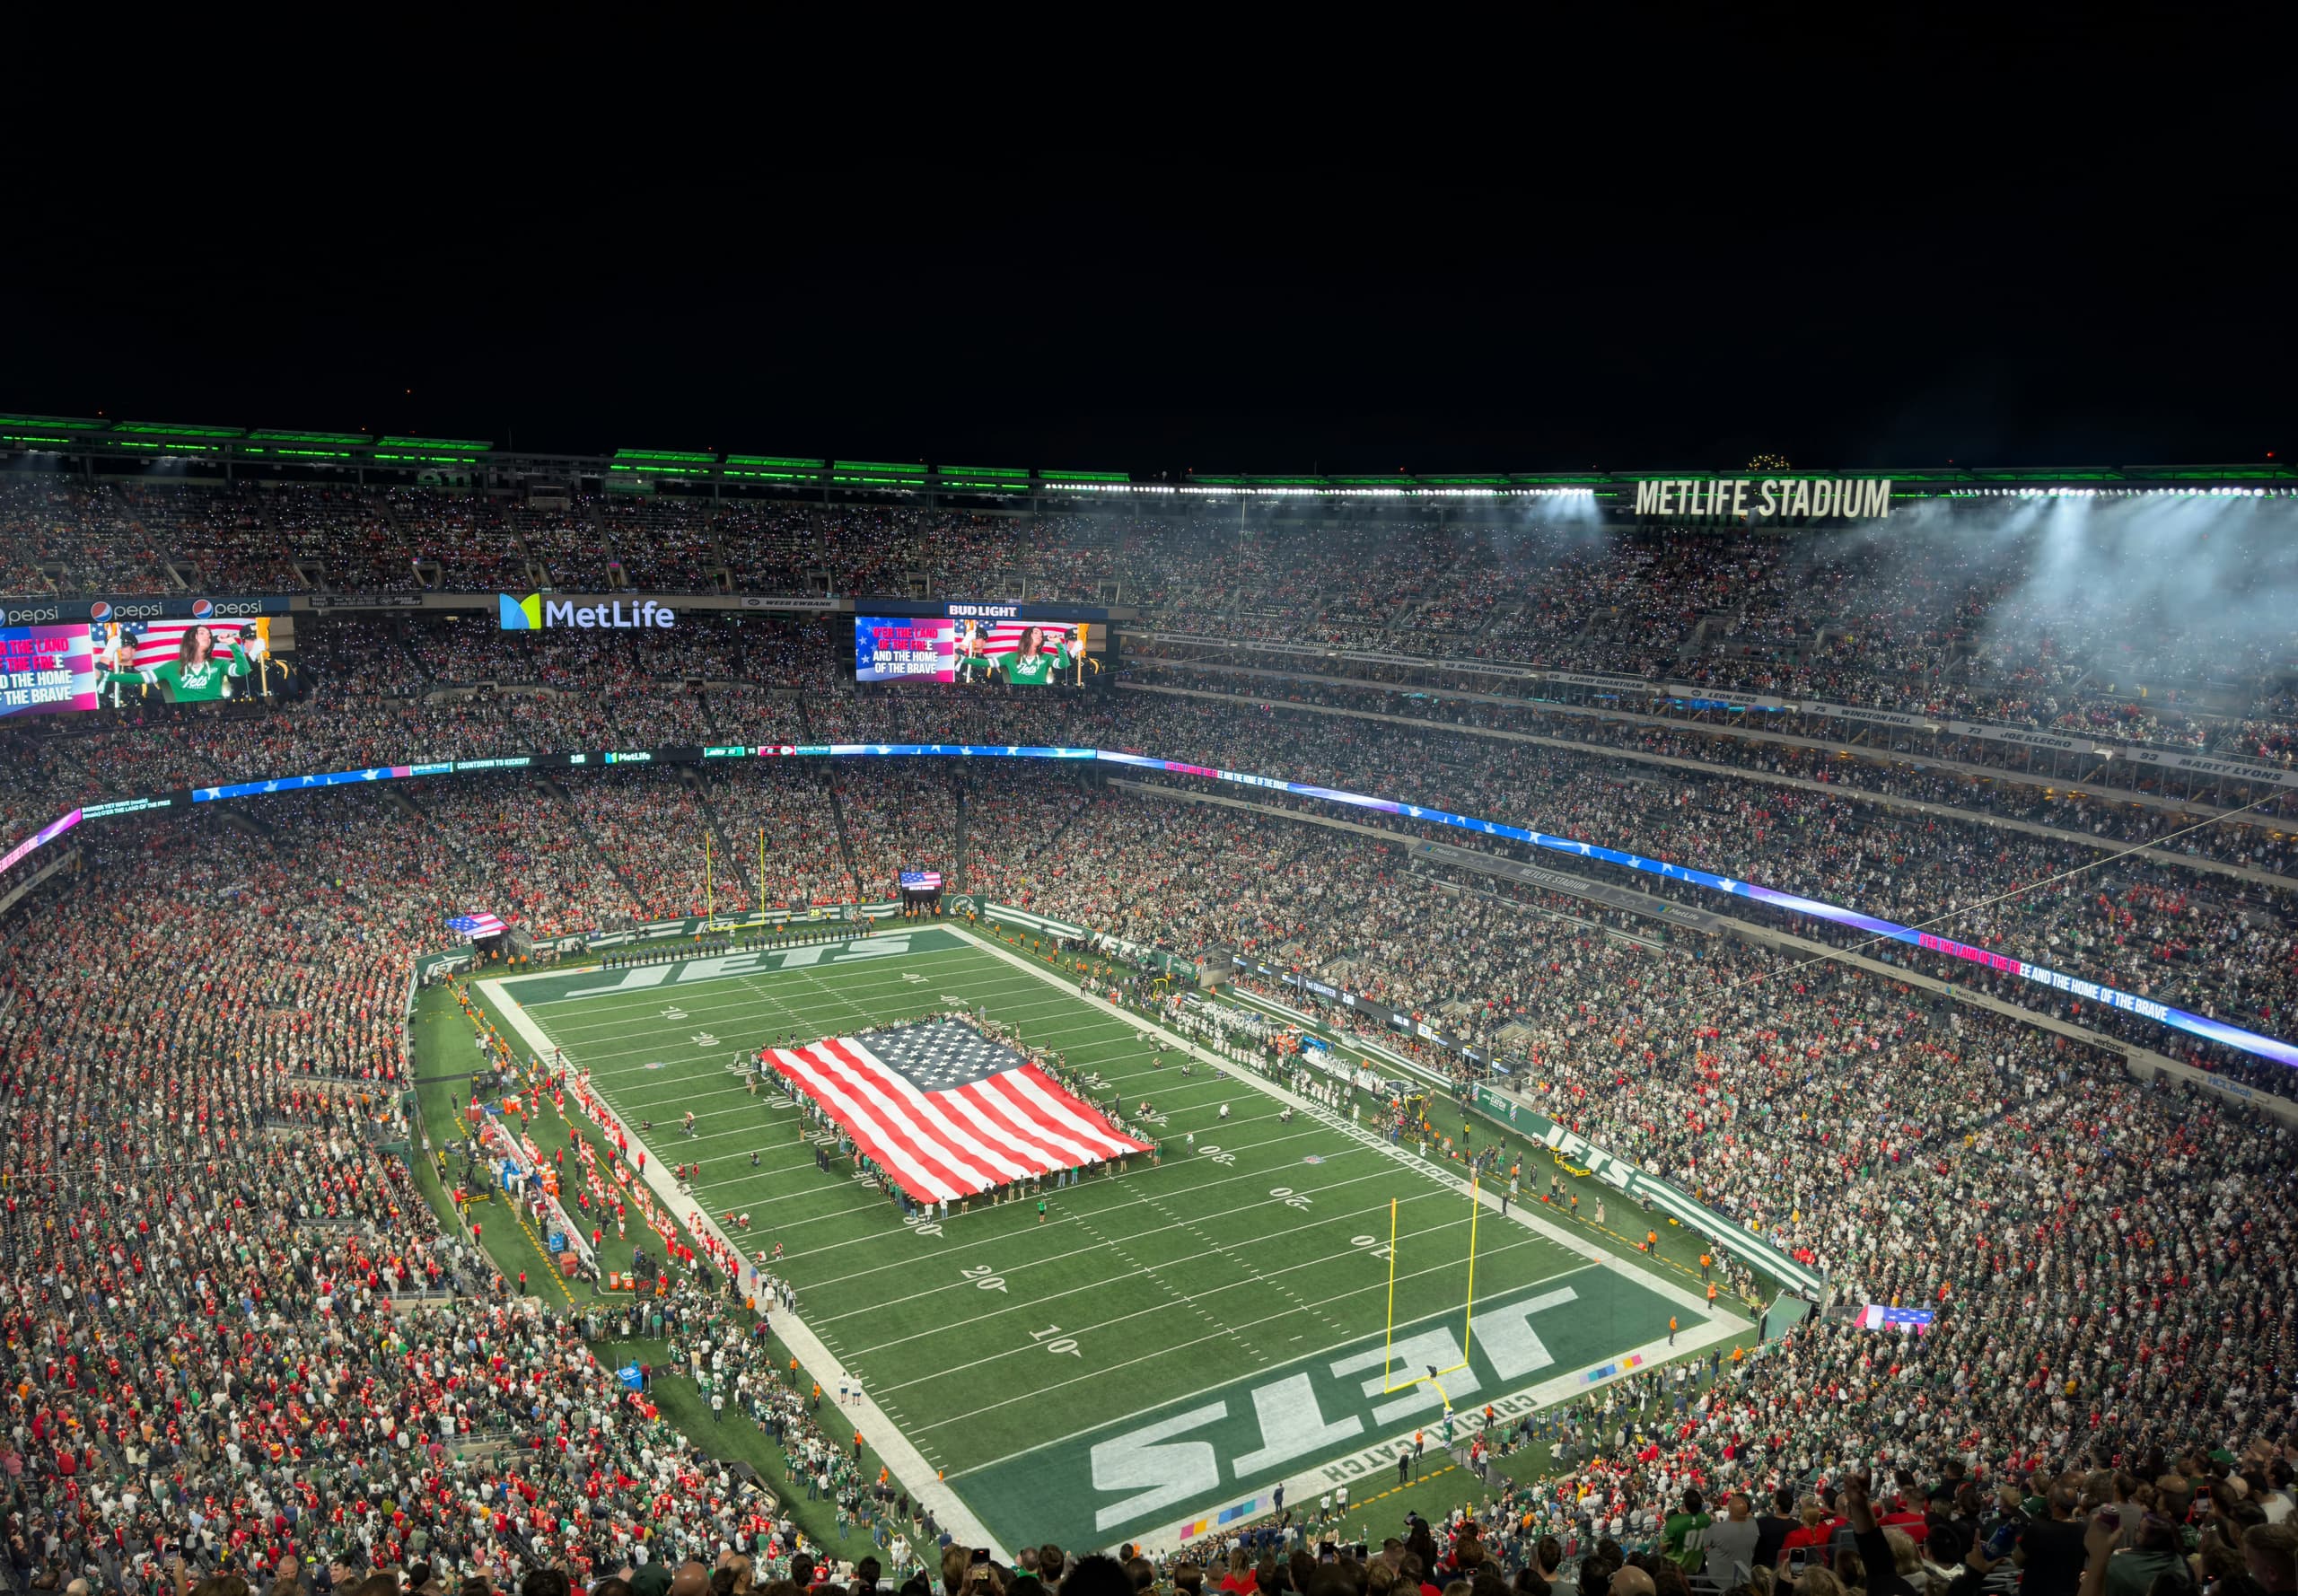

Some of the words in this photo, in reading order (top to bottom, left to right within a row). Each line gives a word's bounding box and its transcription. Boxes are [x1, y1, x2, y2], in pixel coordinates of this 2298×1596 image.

[1636, 479, 1750, 515] METLIFE
[1758, 479, 1890, 517] STADIUM
[8, 605, 58, 625] pepsi
[114, 601, 163, 619] pepsi
[215, 600, 262, 617] pepsi
[546, 600, 674, 628] MetLife
[949, 605, 978, 616] BUD
[978, 606, 1016, 617] LIGHT
[895, 627, 912, 638] THE
[913, 628, 938, 640] LAND
[8, 639, 33, 654] THE
[35, 637, 69, 653] LAND
[878, 639, 890, 650] OF
[891, 639, 908, 650] THE
[6, 656, 31, 671] THE
[873, 652, 891, 662] AND
[893, 652, 911, 662] THE
[912, 652, 938, 662] HOME
[874, 662, 890, 673] OF
[891, 662, 906, 673] THE
[907, 662, 936, 674] BRAVE
[1481, 666, 1524, 676] GASTINEAU
[11, 672, 34, 688] THE
[37, 670, 74, 686] HOME
[181, 674, 207, 688] Jets
[1568, 675, 1595, 684] LARRY
[1596, 679, 1645, 689] GRANTHAM
[5, 689, 30, 706] THE
[31, 686, 74, 704] BRAVE
[1708, 692, 1732, 700] LEON
[1733, 695, 1757, 704] HESS
[1841, 708, 1887, 722] WINSTON
[1888, 715, 1911, 724] HILL
[2000, 732, 2023, 741] JOE
[2024, 734, 2073, 748] KLECKO
[457, 759, 495, 769] COUNTDOWN
[618, 752, 651, 761] MetLife
[2139, 752, 2159, 761] 93
[2178, 759, 2231, 772] MARTY
[2232, 765, 2284, 781] LYONS
[1520, 868, 1553, 885] METLIFE
[1552, 876, 1590, 891] STADIUM
[564, 934, 912, 997] JETS
[1919, 933, 1938, 949] O'ER
[1939, 939, 1954, 956] THE
[1956, 943, 1979, 961] LAND
[1979, 951, 1991, 965] OF
[1993, 954, 2008, 971] THE
[2009, 959, 2031, 978] FREE
[2031, 968, 2050, 985] AND
[2052, 972, 2071, 990] THE
[2071, 978, 2098, 999] HOME
[2100, 987, 2114, 1003] OF
[2116, 992, 2135, 1011] THE
[2135, 998, 2168, 1022] BRAVE
[1314, 983, 1337, 997] QUARTER
[661, 1006, 689, 1020] 10
[2092, 1037, 2124, 1053] verizon
[1198, 1145, 1235, 1163] 30
[1303, 1105, 1394, 1150] INTERCEPT
[1393, 1150, 1465, 1188] CANCER
[1531, 1125, 1635, 1189] JETS
[1269, 1188, 1313, 1206] 20
[1351, 1235, 1398, 1259] 10
[960, 1265, 1006, 1291] 20
[1030, 1324, 1078, 1355] 10
[1090, 1285, 1579, 1533] JETS
[1321, 1440, 1416, 1483] CATCH
